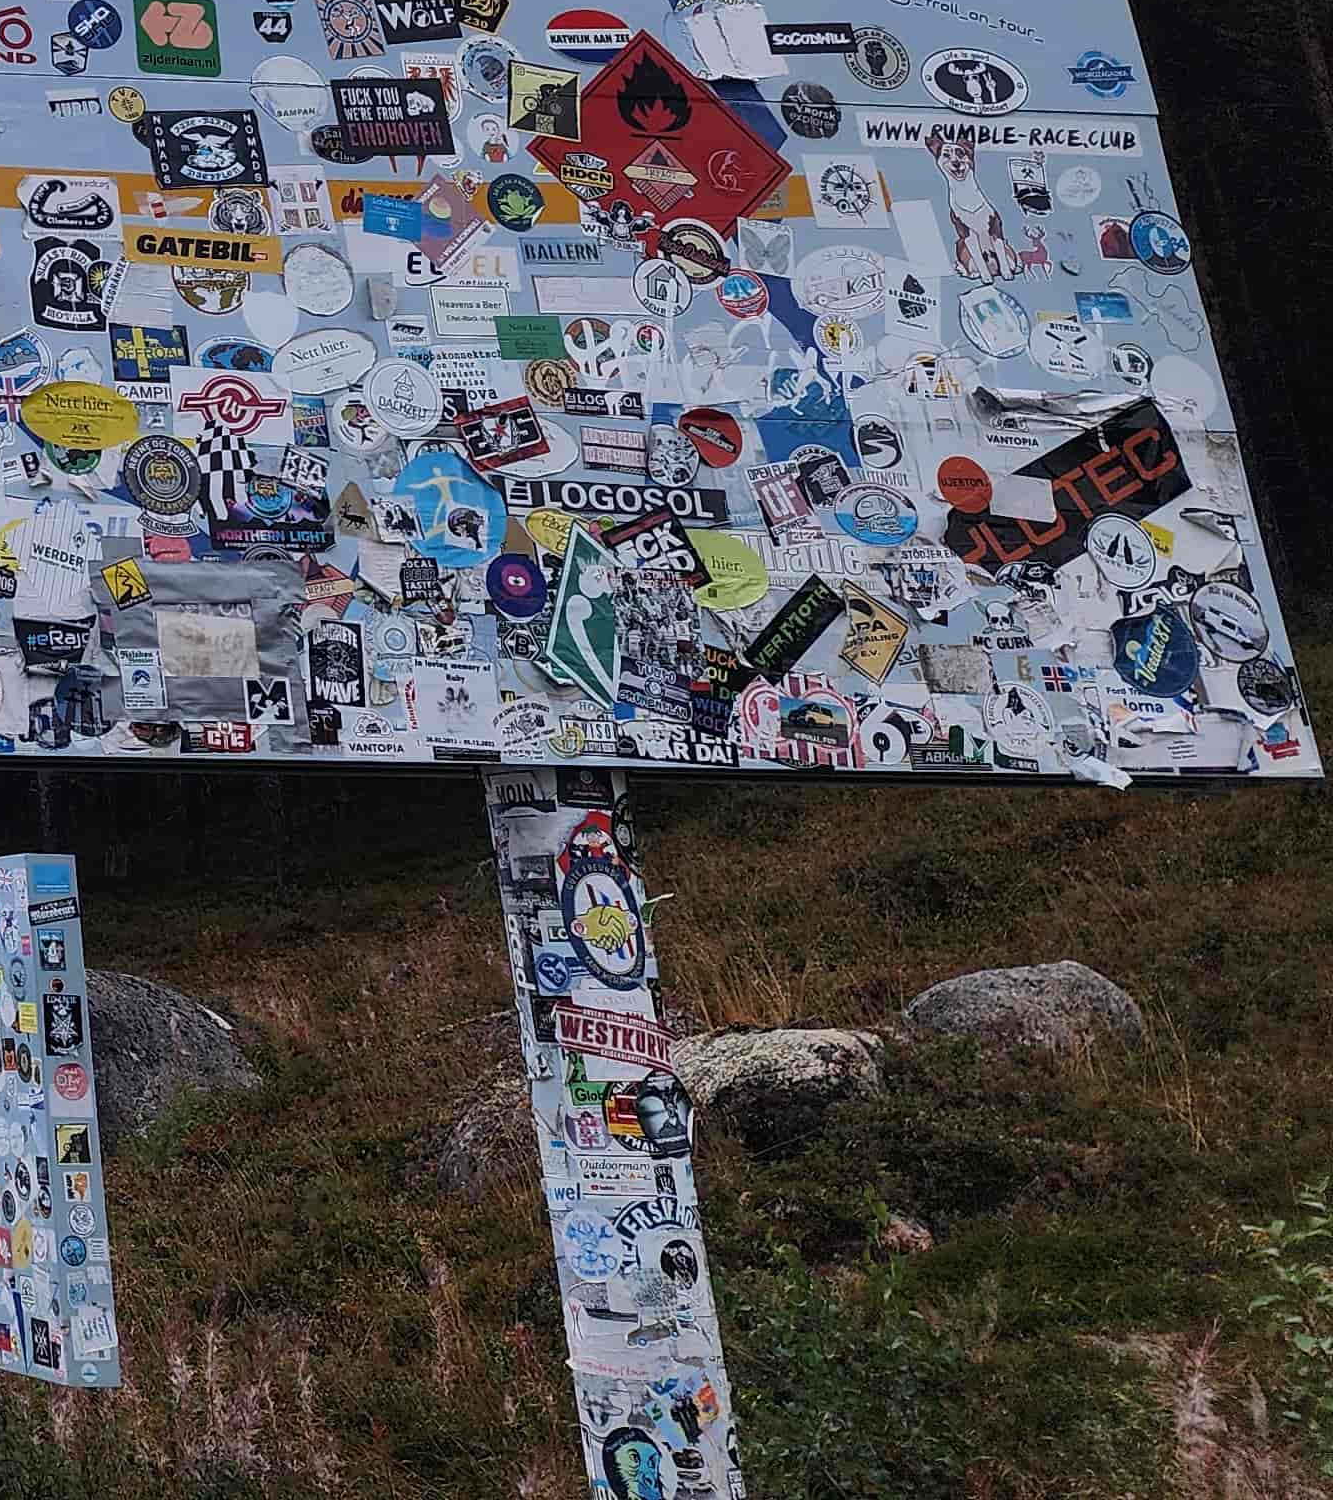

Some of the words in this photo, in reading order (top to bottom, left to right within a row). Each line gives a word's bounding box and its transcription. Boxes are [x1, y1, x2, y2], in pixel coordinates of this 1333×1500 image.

[141, 54, 217, 67] zijderlaan.nl
[341, 88, 369, 105] FUCK
[373, 86, 399, 104] YOU
[345, 106, 374, 121] WE'RE
[377, 105, 403, 120] FROM
[562, 169, 612, 185] HDCN
[137, 234, 253, 262] GATEBIL
[525, 244, 598, 261] BALLERN
[987, 436, 1039, 448] VANTOPIA
[548, 485, 712, 519] LOGOSOL
[561, 1017, 670, 1063] WESTKURVE
